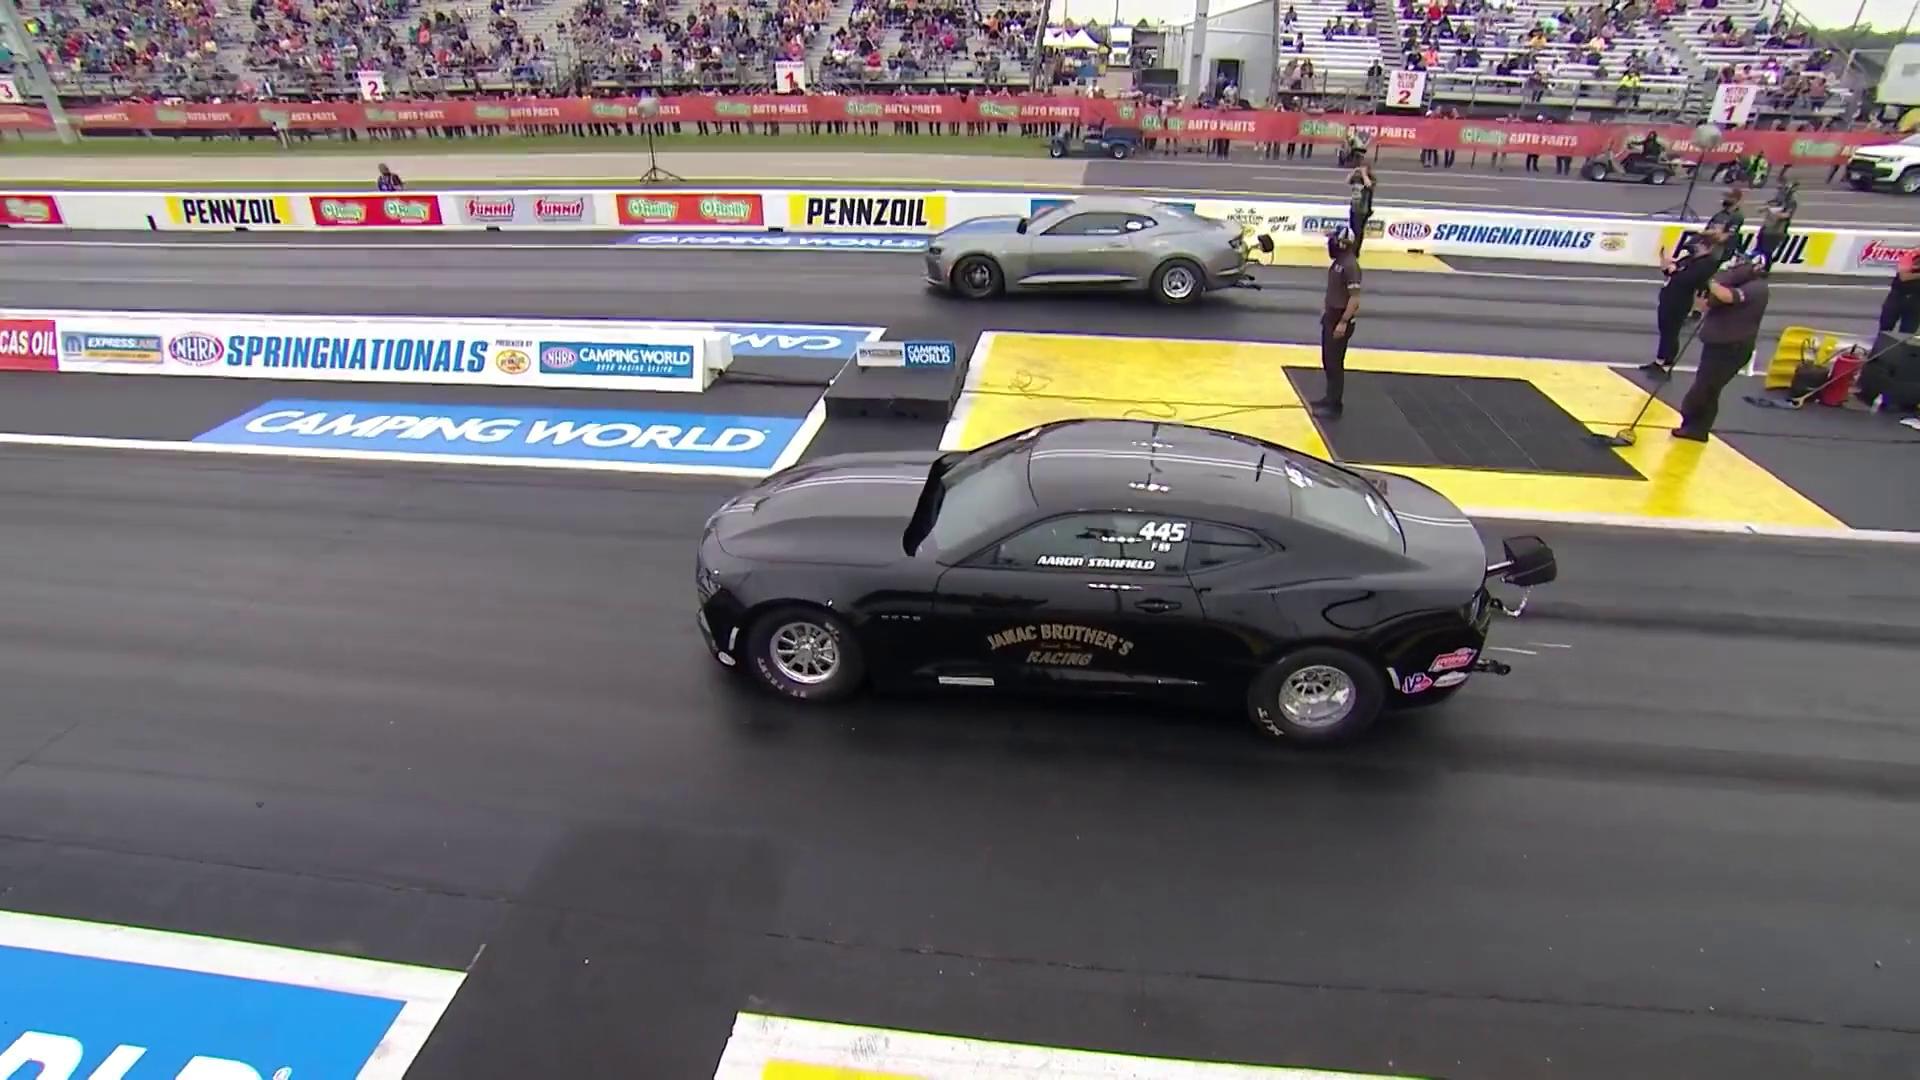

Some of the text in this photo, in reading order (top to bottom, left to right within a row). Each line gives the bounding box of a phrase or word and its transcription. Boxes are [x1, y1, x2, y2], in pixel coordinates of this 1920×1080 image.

[367, 81, 380, 95] 2
[785, 71, 794, 89] 1
[1398, 90, 1411, 104] 2
[1725, 105, 1735, 120] 1
[1187, 119, 1217, 130] AUTO
[1219, 120, 1256, 132] PARTS
[1380, 127, 1417, 139] PARTS
[183, 199, 281, 224] PENNZOIL
[807, 198, 928, 226] PENNZOIL
[1433, 224, 1595, 249] SPRINGNATIONALS
[32, 332, 56, 356] OIL
[174, 341, 217, 361] NHRA
[907, 345, 950, 353] CAMPING
[226, 335, 488, 373] SPRINGNATIONALS
[545, 348, 576, 365] NHRA
[579, 347, 690, 366] CAMPING WORLD
[909, 352, 951, 364] WORLD
[244, 409, 770, 453] CAMPING WORLD
[1139, 521, 1187, 542] 445
[1037, 555, 1084, 567] AARON
[1026, 650, 1093, 666] RACING
